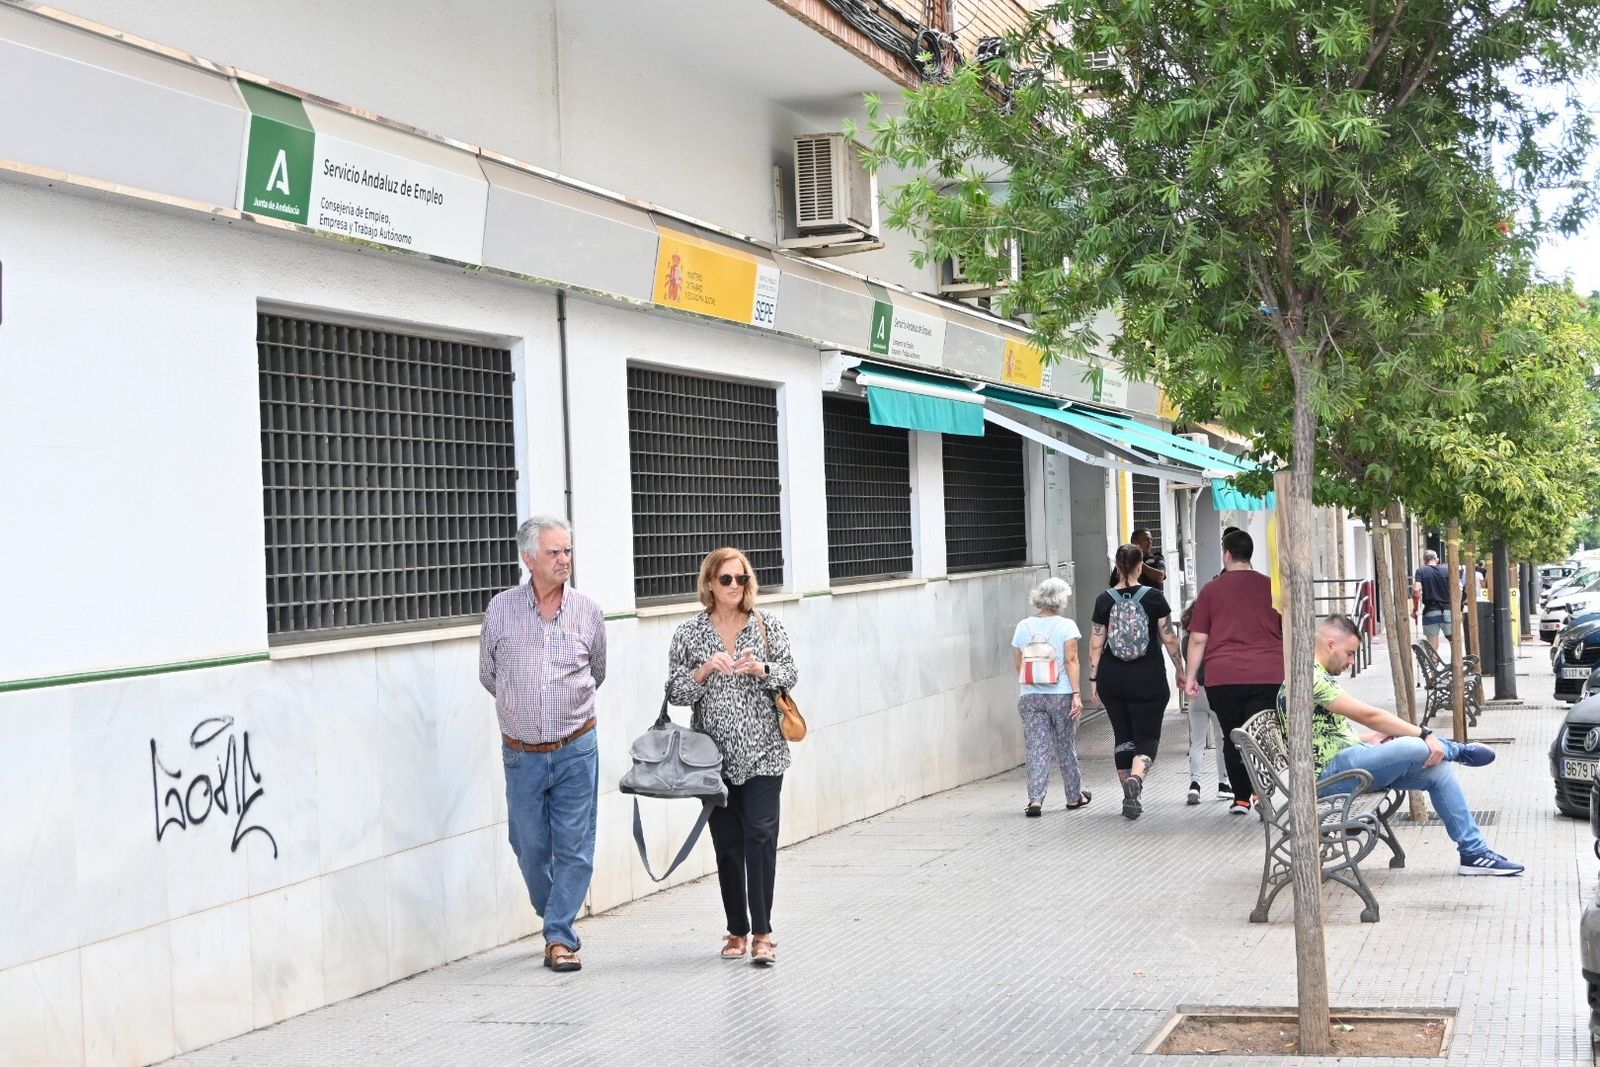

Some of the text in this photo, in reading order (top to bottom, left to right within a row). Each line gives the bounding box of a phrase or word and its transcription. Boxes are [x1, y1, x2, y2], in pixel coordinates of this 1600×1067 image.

[323, 158, 444, 206] Servicio Andaluz de Empleo
[253, 197, 269, 208] Junta
[275, 202, 300, 215] Andalucía
[320, 197, 391, 226] Consejería de Empleo,
[319, 213, 348, 230] Empresa
[353, 221, 379, 239] Trabajo
[379, 227, 413, 245] Autónomo
[754, 299, 775, 324] SEPE
[1565, 761, 1588, 778] 9679
